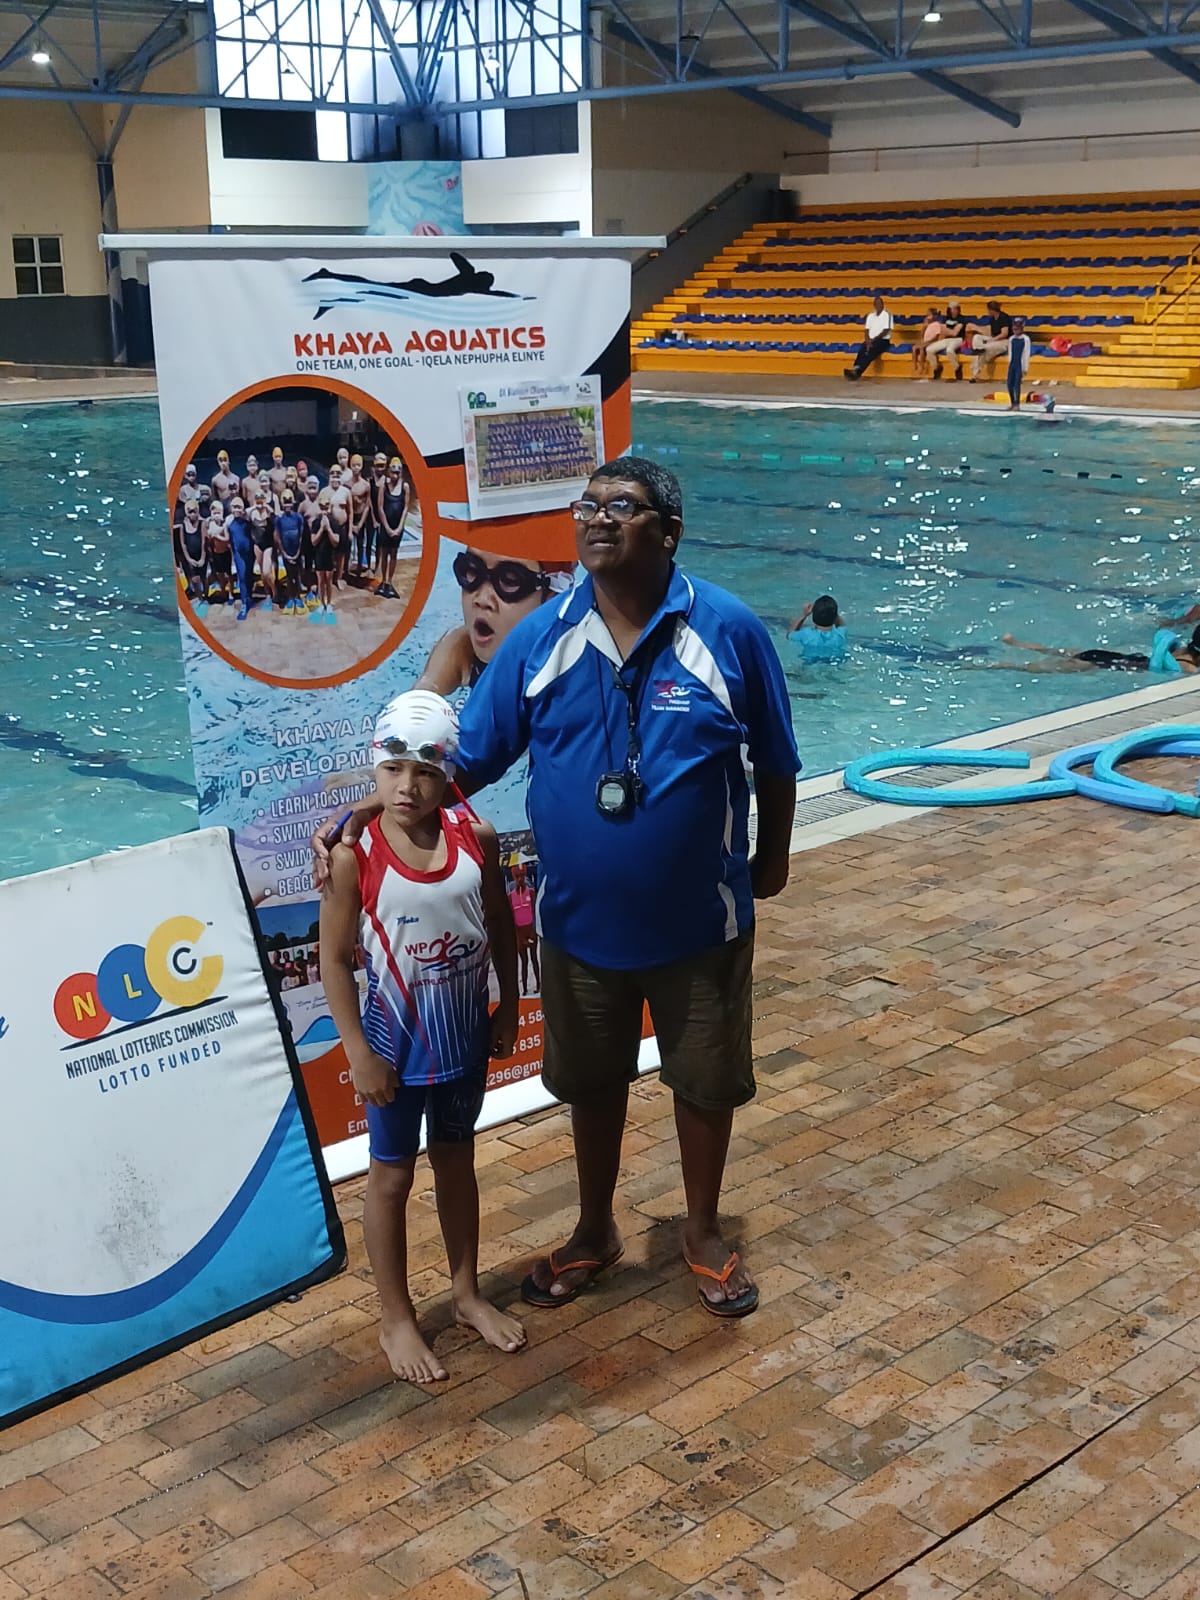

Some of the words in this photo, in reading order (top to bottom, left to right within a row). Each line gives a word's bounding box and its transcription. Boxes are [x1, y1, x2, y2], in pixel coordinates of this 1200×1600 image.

[294, 332, 393, 357] KHAYA
[405, 326, 546, 353] AQUATICS
[296, 359, 320, 372] ONE
[322, 358, 358, 372] TEAM,
[359, 357, 383, 369] ONE
[385, 356, 413, 368] GOAL
[422, 354, 452, 367] IQELA
[454, 352, 510, 365] NEPHUPHA
[512, 351, 546, 363] ELINYE
[276, 718, 354, 748] KHAYA
[271, 794, 312, 818] LEARN
[314, 791, 329, 810] TO
[331, 783, 367, 806] SWIM
[273, 820, 311, 844] SWIM
[276, 847, 313, 871] SWIM
[405, 942, 427, 956] WP
[528, 1009, 545, 1025] 58
[65, 1050, 120, 1079] NATIONAL
[120, 1031, 173, 1061] LOTTERIES
[174, 1009, 239, 1043] COMMISSION
[520, 1034, 541, 1051] 835
[99, 1064, 151, 1093] LOTTO
[158, 1040, 221, 1073] FUNDED
[486, 1059, 543, 1087] 296@gm
